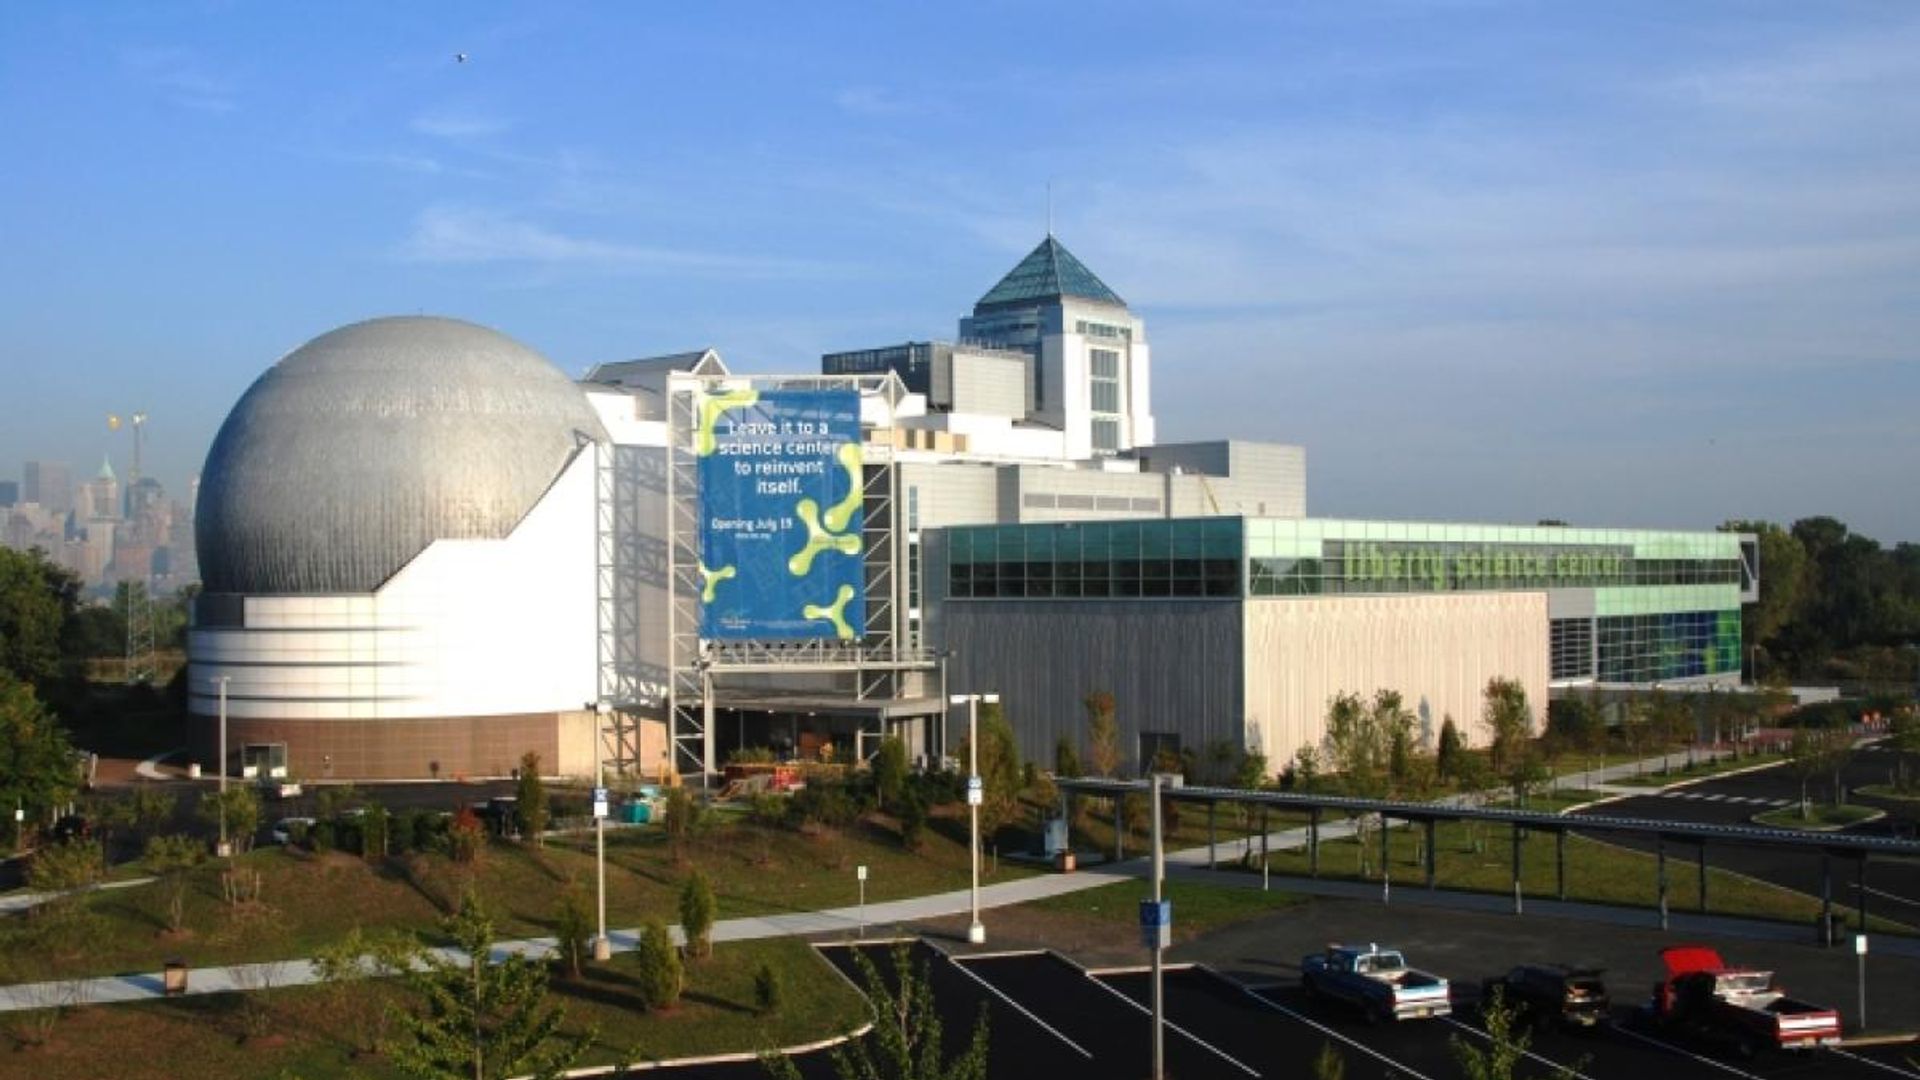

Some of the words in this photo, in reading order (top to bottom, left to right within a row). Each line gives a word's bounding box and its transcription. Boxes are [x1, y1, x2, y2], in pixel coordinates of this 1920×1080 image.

[729, 421, 777, 435] Leave
[781, 419, 792, 435] it
[798, 420, 813, 435] to
[818, 423, 829, 435] a
[719, 439, 782, 455] science
[785, 441, 836, 456] center
[734, 461, 752, 475] to
[755, 460, 825, 475] reinvent
[757, 477, 803, 494] itself.
[711, 517, 754, 532] Opening
[756, 517, 777, 532] July
[1344, 541, 1445, 590] liberty
[1456, 545, 1546, 577] science
[1556, 551, 1623, 577] center
